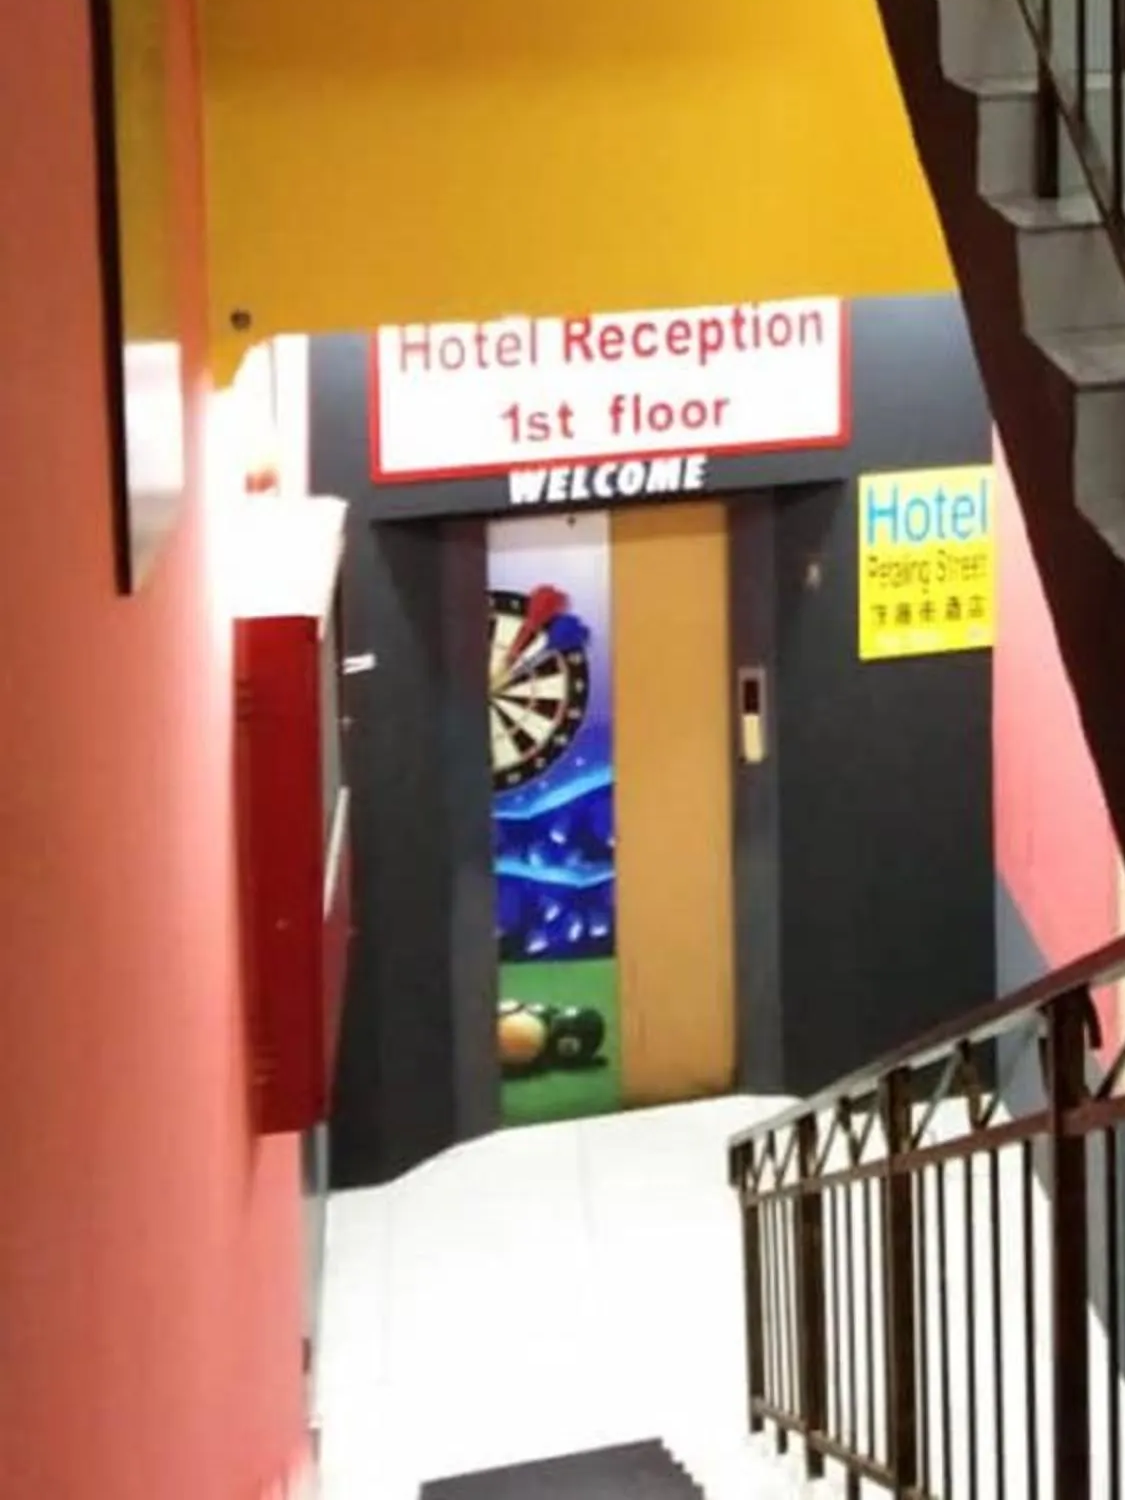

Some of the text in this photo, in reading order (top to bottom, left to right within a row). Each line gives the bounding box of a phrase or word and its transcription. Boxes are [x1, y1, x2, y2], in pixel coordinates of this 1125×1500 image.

[399, 302, 824, 373] Hotel Reception
[501, 392, 731, 444] 1st floor
[508, 453, 709, 504] WELCOME
[868, 477, 988, 546] Hotel
